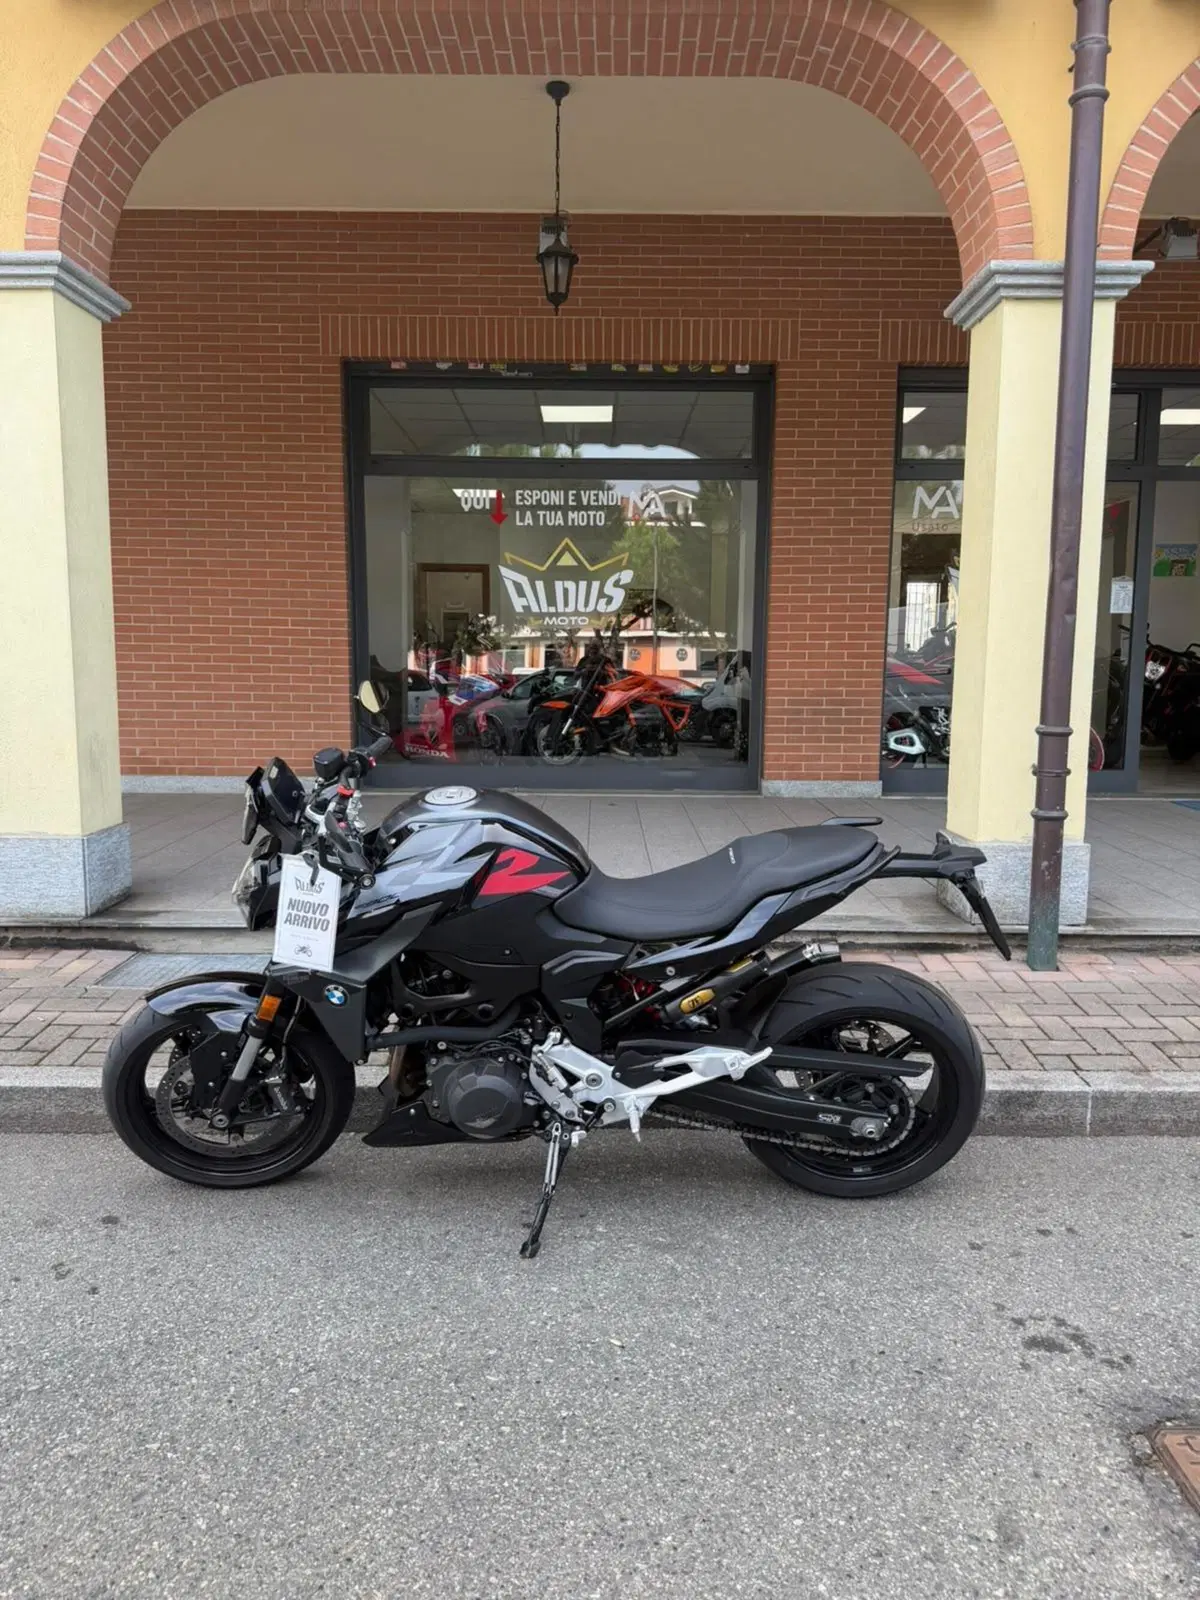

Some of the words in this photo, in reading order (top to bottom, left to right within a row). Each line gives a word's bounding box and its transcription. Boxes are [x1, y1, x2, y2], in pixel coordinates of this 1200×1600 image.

[460, 489, 490, 512] QUI
[515, 489, 564, 506] ESPONI
[568, 489, 578, 506] E
[580, 489, 621, 506] VENDI
[515, 510, 533, 526] LA
[537, 510, 564, 526] TUA
[568, 510, 606, 526] MOTO
[498, 564, 634, 613] ALDUS
[543, 616, 590, 626] MOTO
[287, 898, 330, 917] NUOVO
[284, 912, 331, 932] ARRIVO
